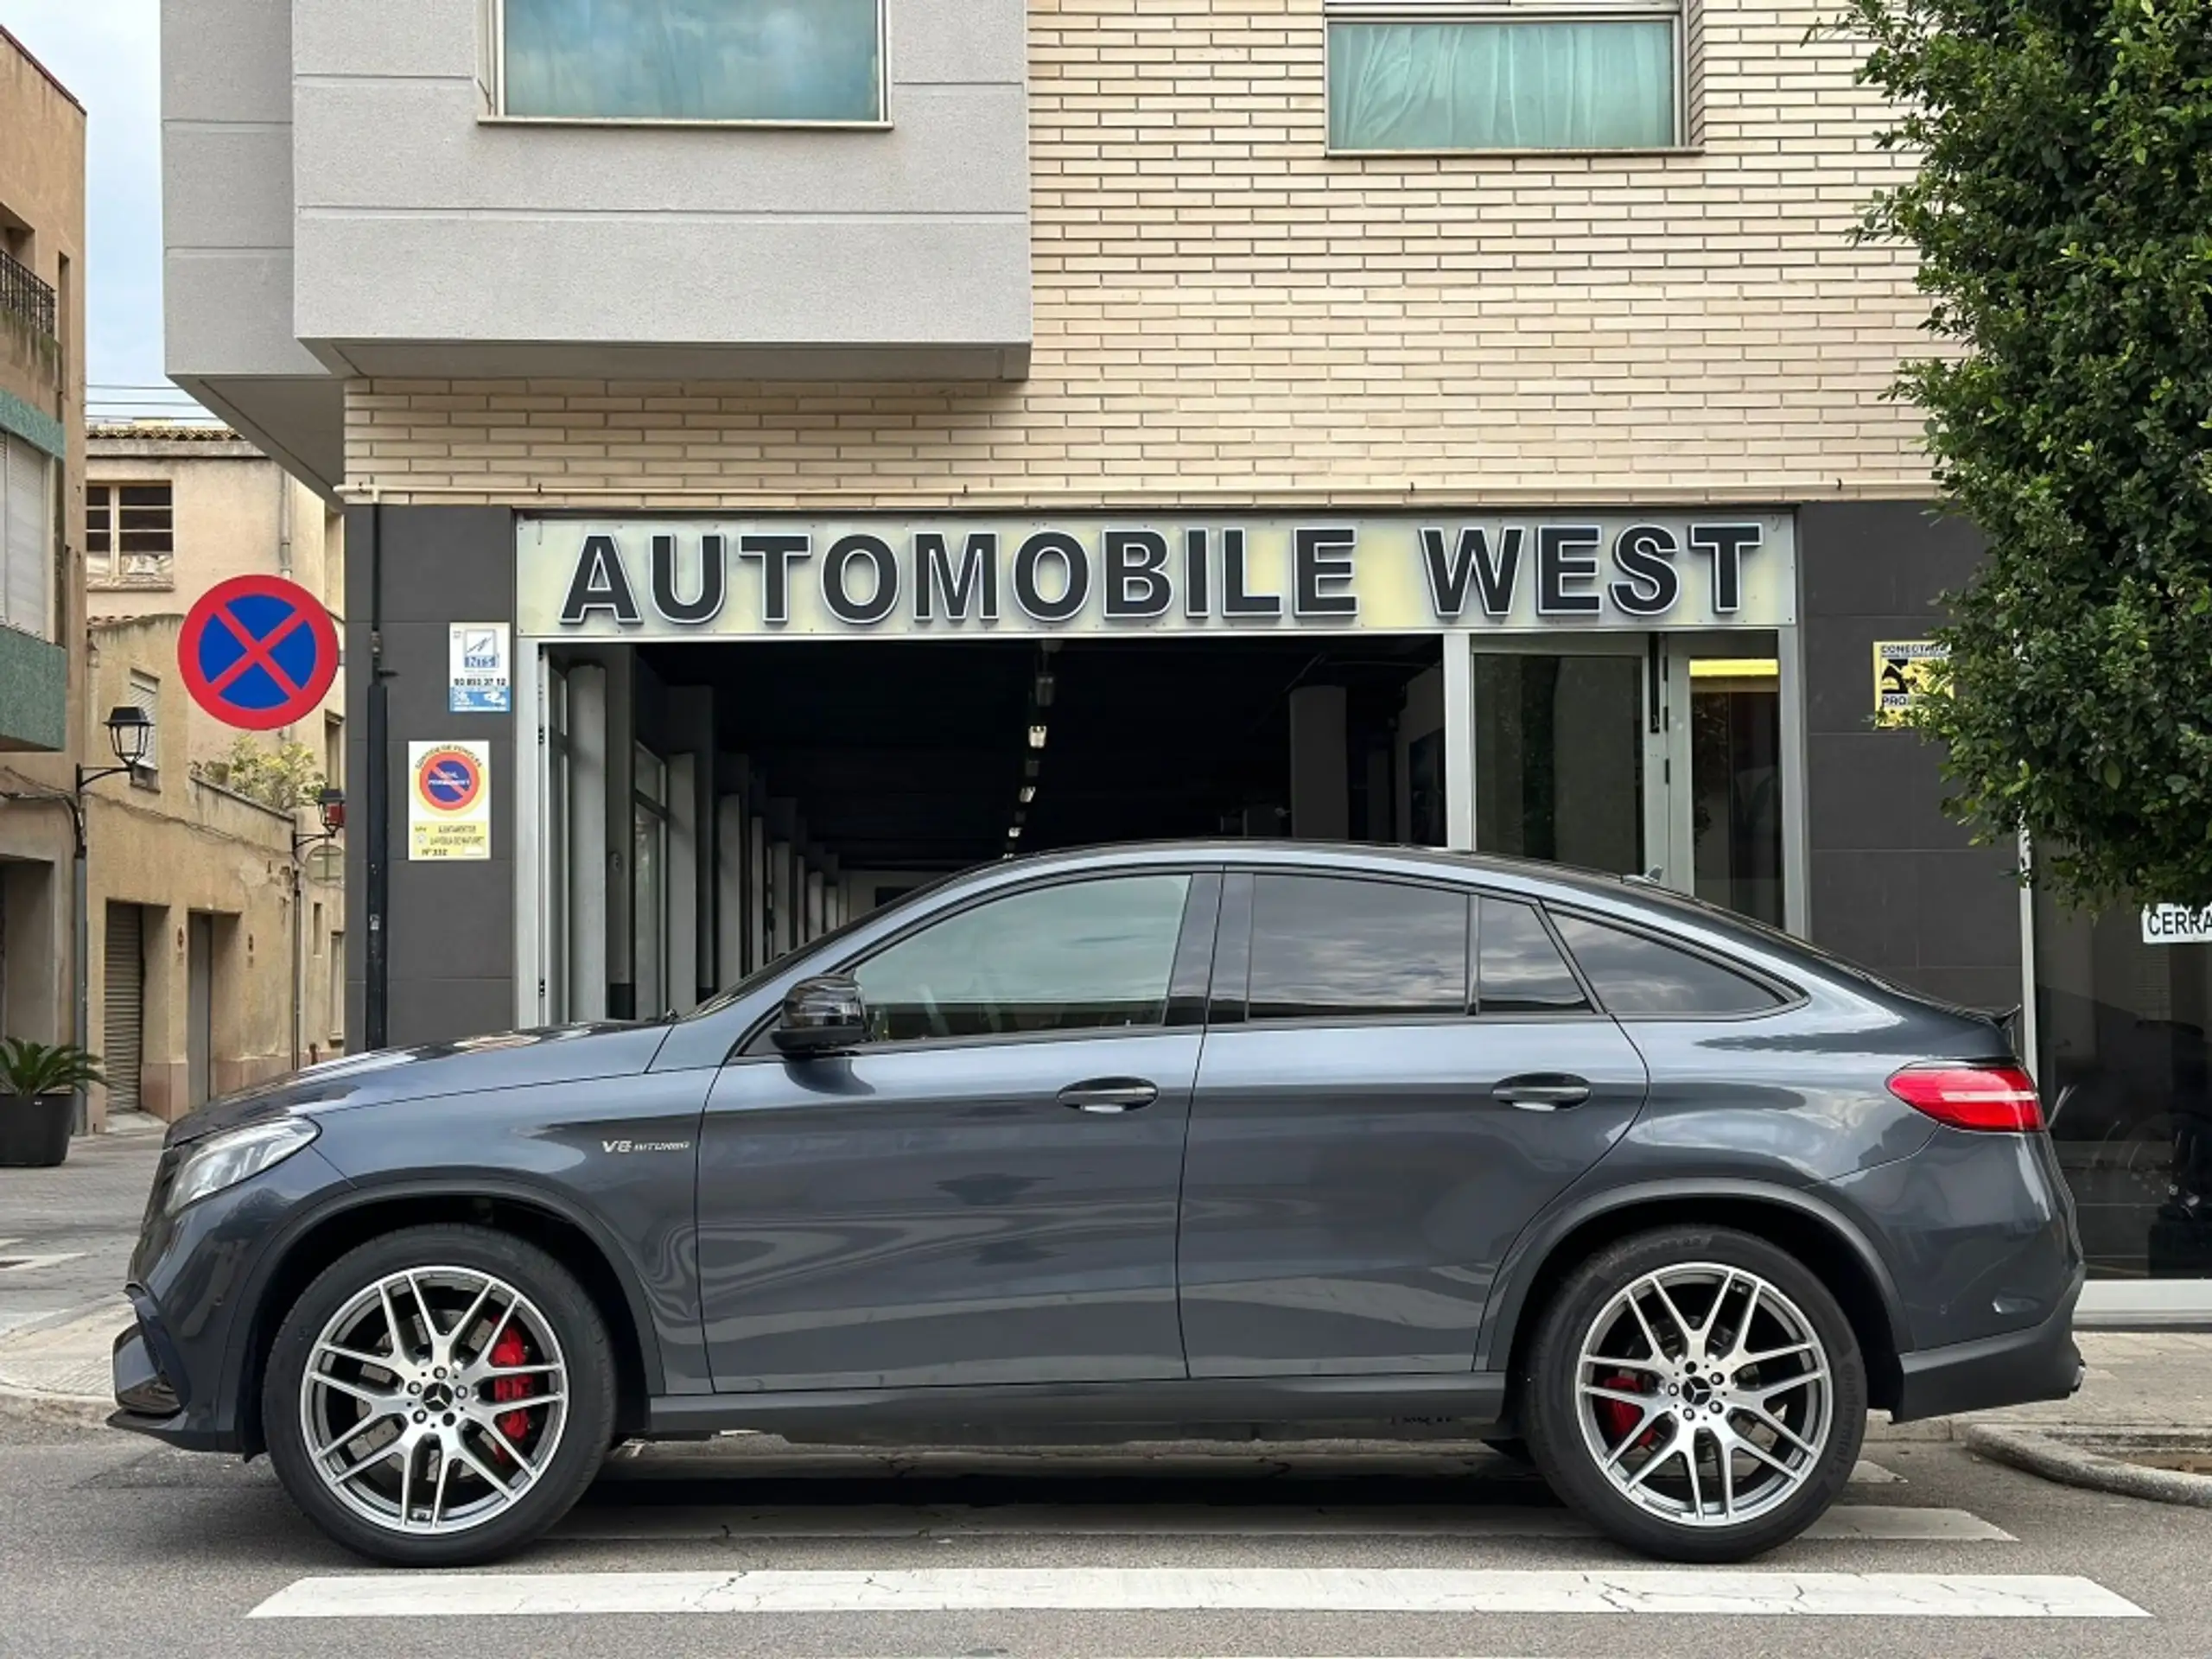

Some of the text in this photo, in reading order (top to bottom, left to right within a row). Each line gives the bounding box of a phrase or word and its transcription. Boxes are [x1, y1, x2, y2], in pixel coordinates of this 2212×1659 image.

[559, 523, 1764, 625] AUTOMOBILE WEST
[1882, 696, 1908, 706] PRO
